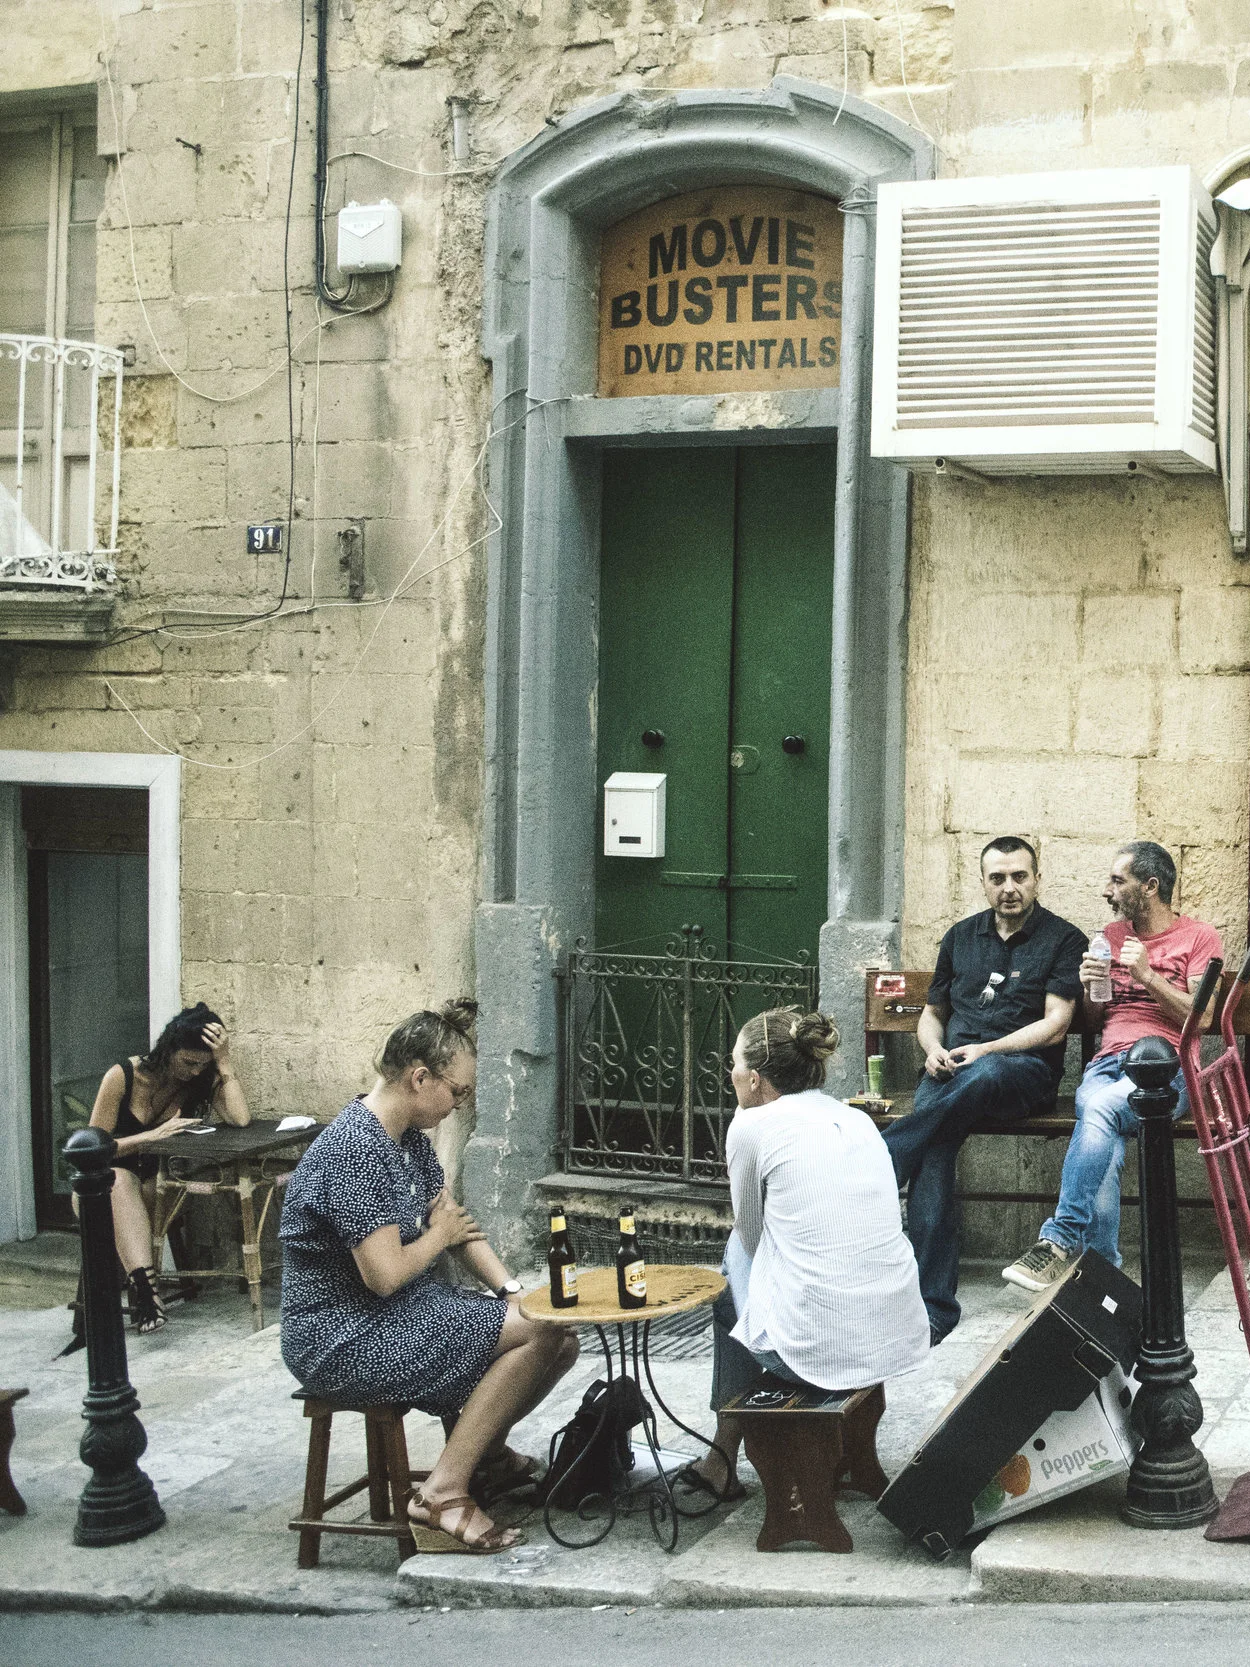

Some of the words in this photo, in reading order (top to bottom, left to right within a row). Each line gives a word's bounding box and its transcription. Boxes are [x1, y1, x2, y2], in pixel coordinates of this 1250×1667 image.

[648, 215, 815, 278] MOVIE
[611, 273, 842, 329] BUSTERS
[624, 342, 684, 375] DVD
[695, 336, 837, 372] RENTALS
[253, 528, 275, 549] 91
[630, 1273, 646, 1282] CIS
